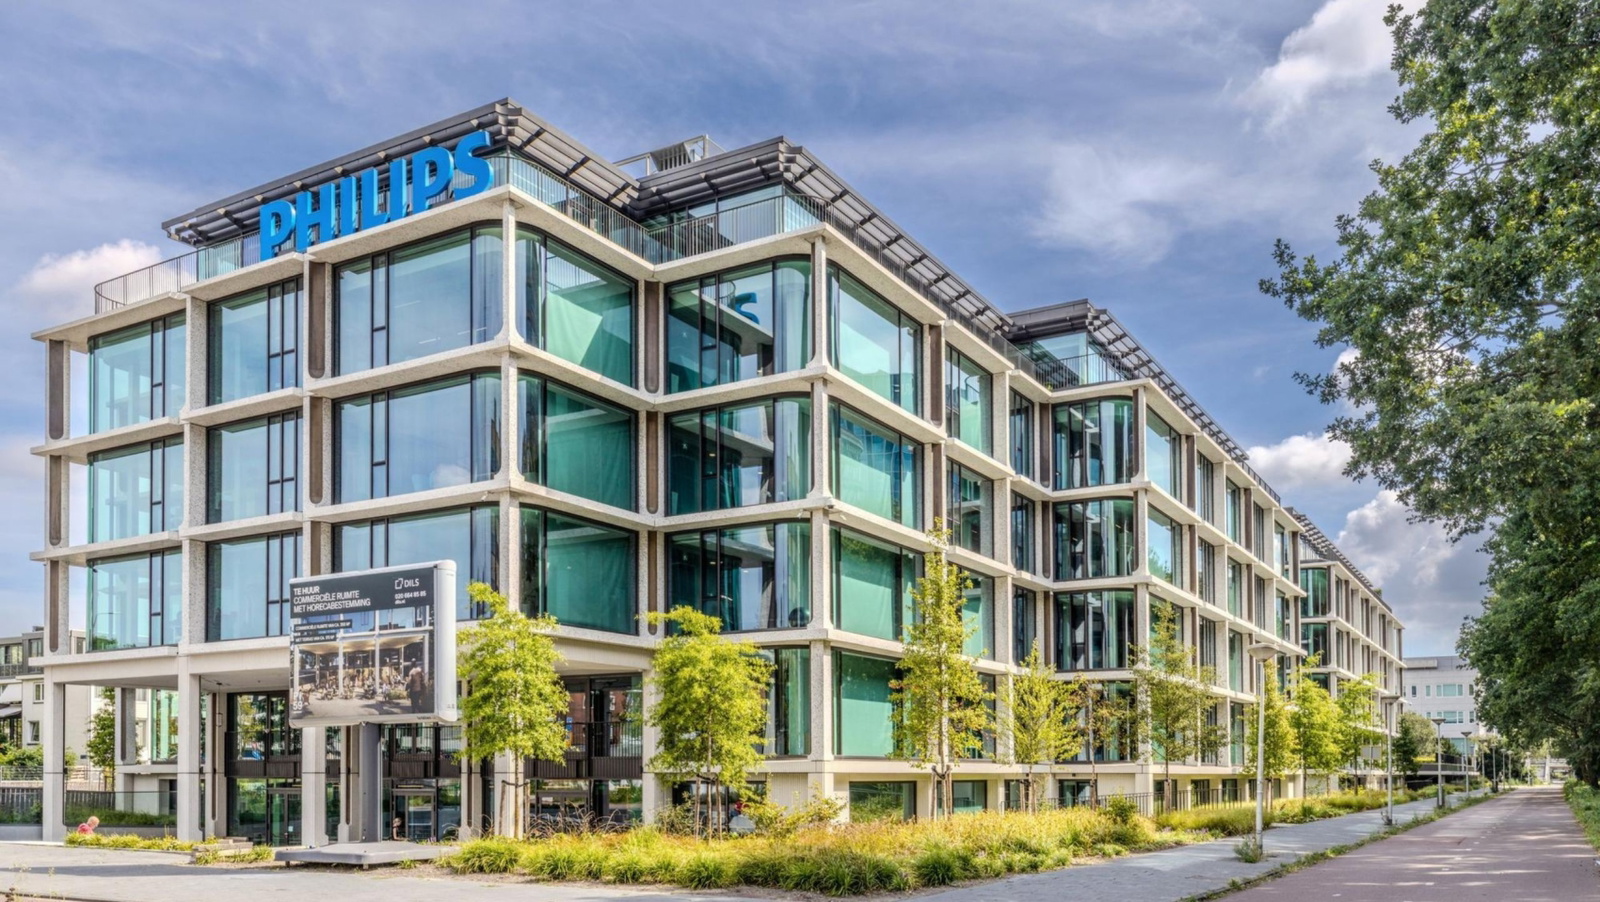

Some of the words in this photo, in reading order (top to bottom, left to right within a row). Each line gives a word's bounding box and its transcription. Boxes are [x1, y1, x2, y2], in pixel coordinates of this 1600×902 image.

[259, 129, 494, 261] PHILIPS
[404, 578, 419, 587] DILS
[294, 592, 336, 604] COMMERCIËLE
[336, 590, 360, 599] RUIMTE
[302, 586, 320, 594] HUUR
[294, 604, 306, 613] MET
[306, 599, 371, 611] HORECABESTEMMING
